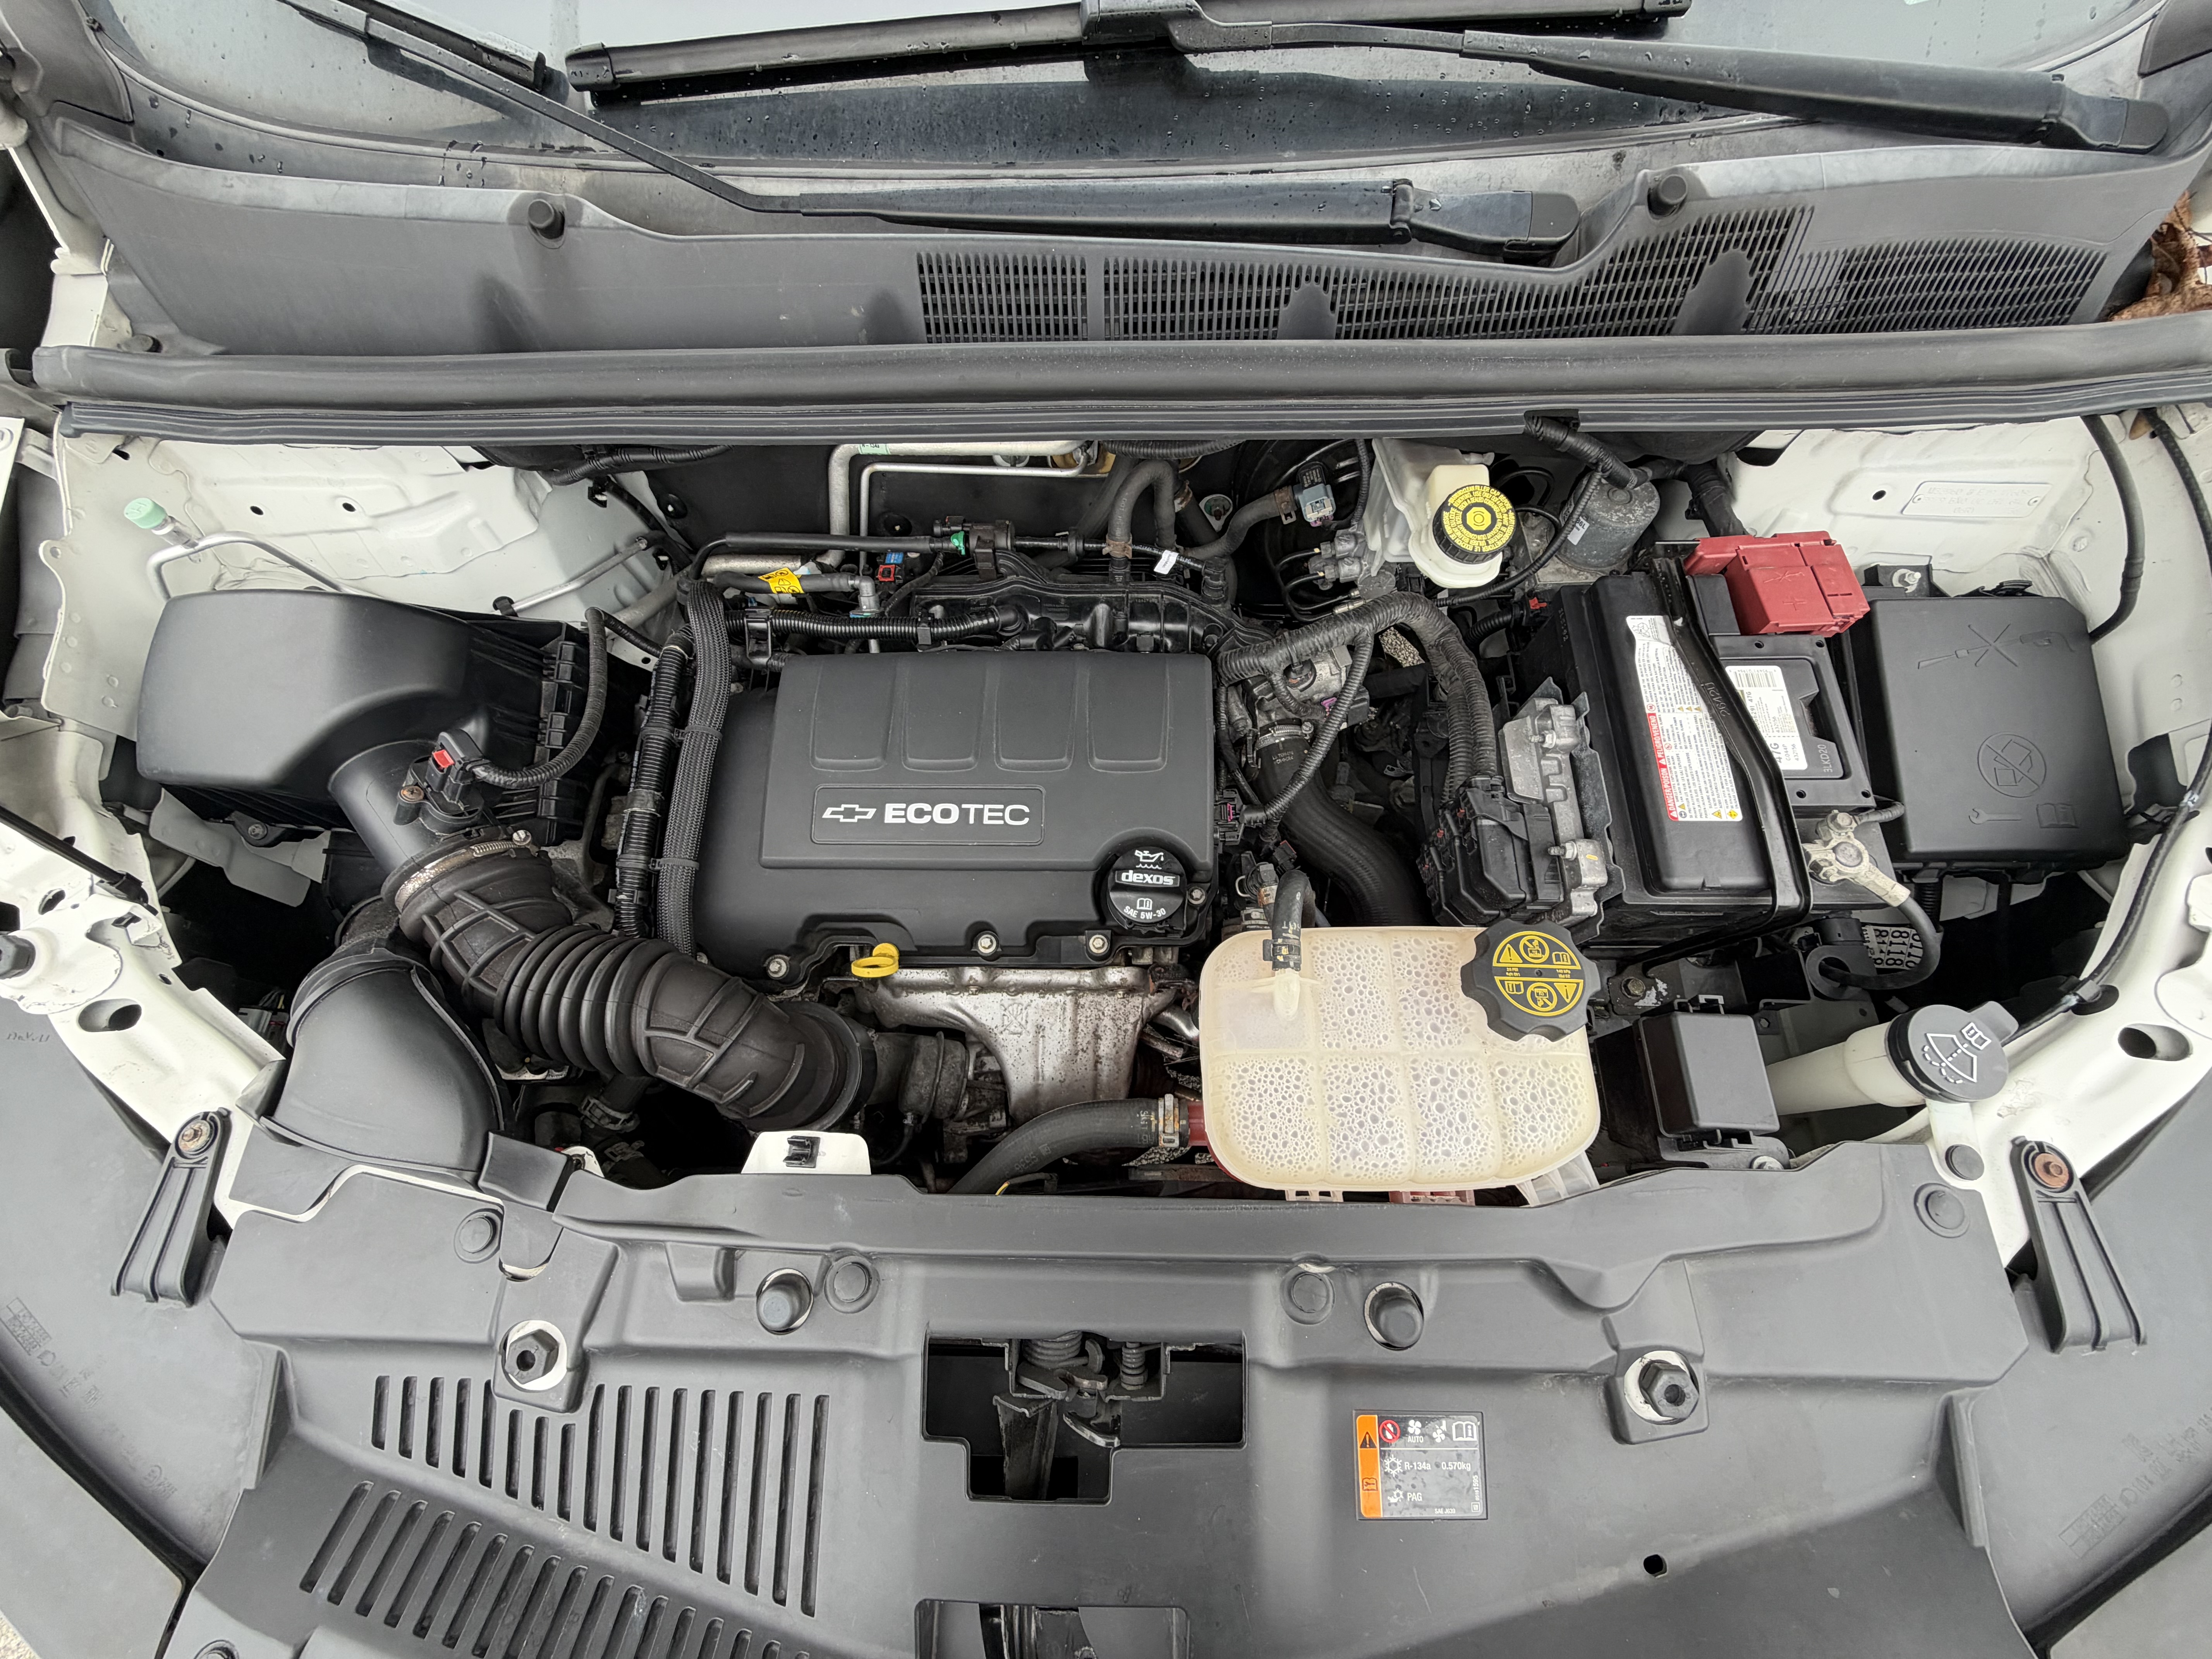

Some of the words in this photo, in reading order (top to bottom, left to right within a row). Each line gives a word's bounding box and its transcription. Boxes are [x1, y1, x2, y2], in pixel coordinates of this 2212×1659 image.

[1489, 488, 1501, 496] CAP
[1498, 493, 1512, 510] BEFORE
[1745, 691, 1753, 702] 47G
[1771, 716, 1780, 733] 432156
[1649, 715, 1664, 757] PELIGRO/VENENO
[1769, 742, 1784, 763] 47G
[1790, 744, 1800, 761] 432156
[1817, 747, 1833, 772] 3LKD20
[1660, 768, 1676, 810] DANGER/POISON
[884, 803, 1030, 826] ECOTEC
[1121, 870, 1176, 885] dexos
[1123, 905, 1139, 918] SAE
[1140, 908, 1166, 919] 5W-30
[1886, 930, 1910, 966] 8118
[1404, 1462, 1431, 1470] R-134a
[1441, 1462, 1471, 1471] 0.570kg
[1407, 1492, 1422, 1502] PAG
